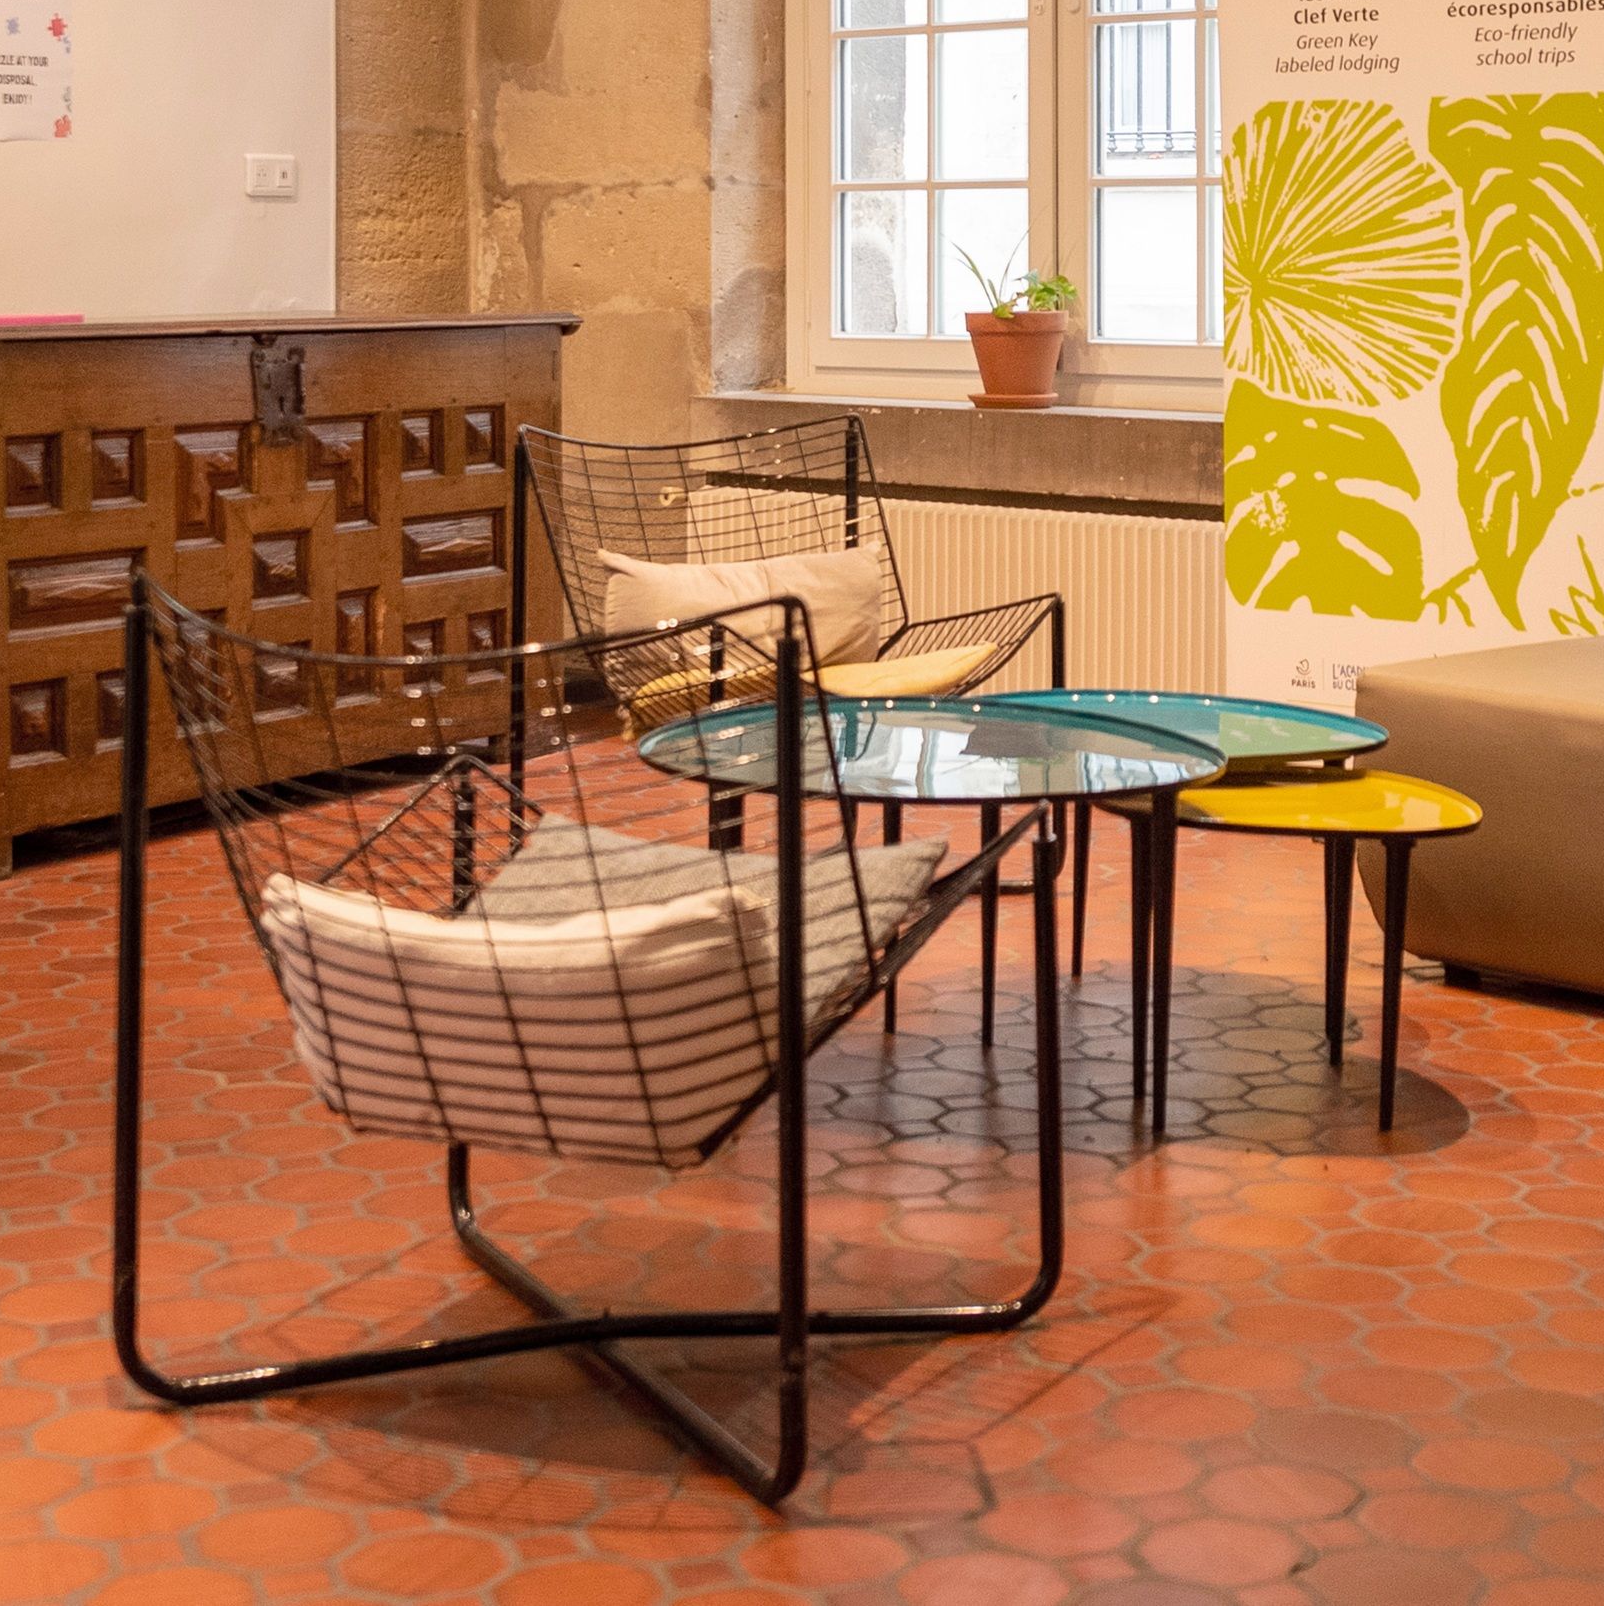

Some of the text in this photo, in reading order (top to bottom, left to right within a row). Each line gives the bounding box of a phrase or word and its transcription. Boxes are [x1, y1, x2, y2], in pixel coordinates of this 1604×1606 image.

[1293, 7, 1380, 25] Clef Verte
[1296, 32, 1379, 51] Green Key
[1474, 21, 1579, 43] Eco-friendly
[28, 56, 49, 67] YOUR
[1275, 54, 1401, 75] labeled lodging
[1476, 47, 1576, 67] school trips
[1291, 678, 1316, 689] PARIS
